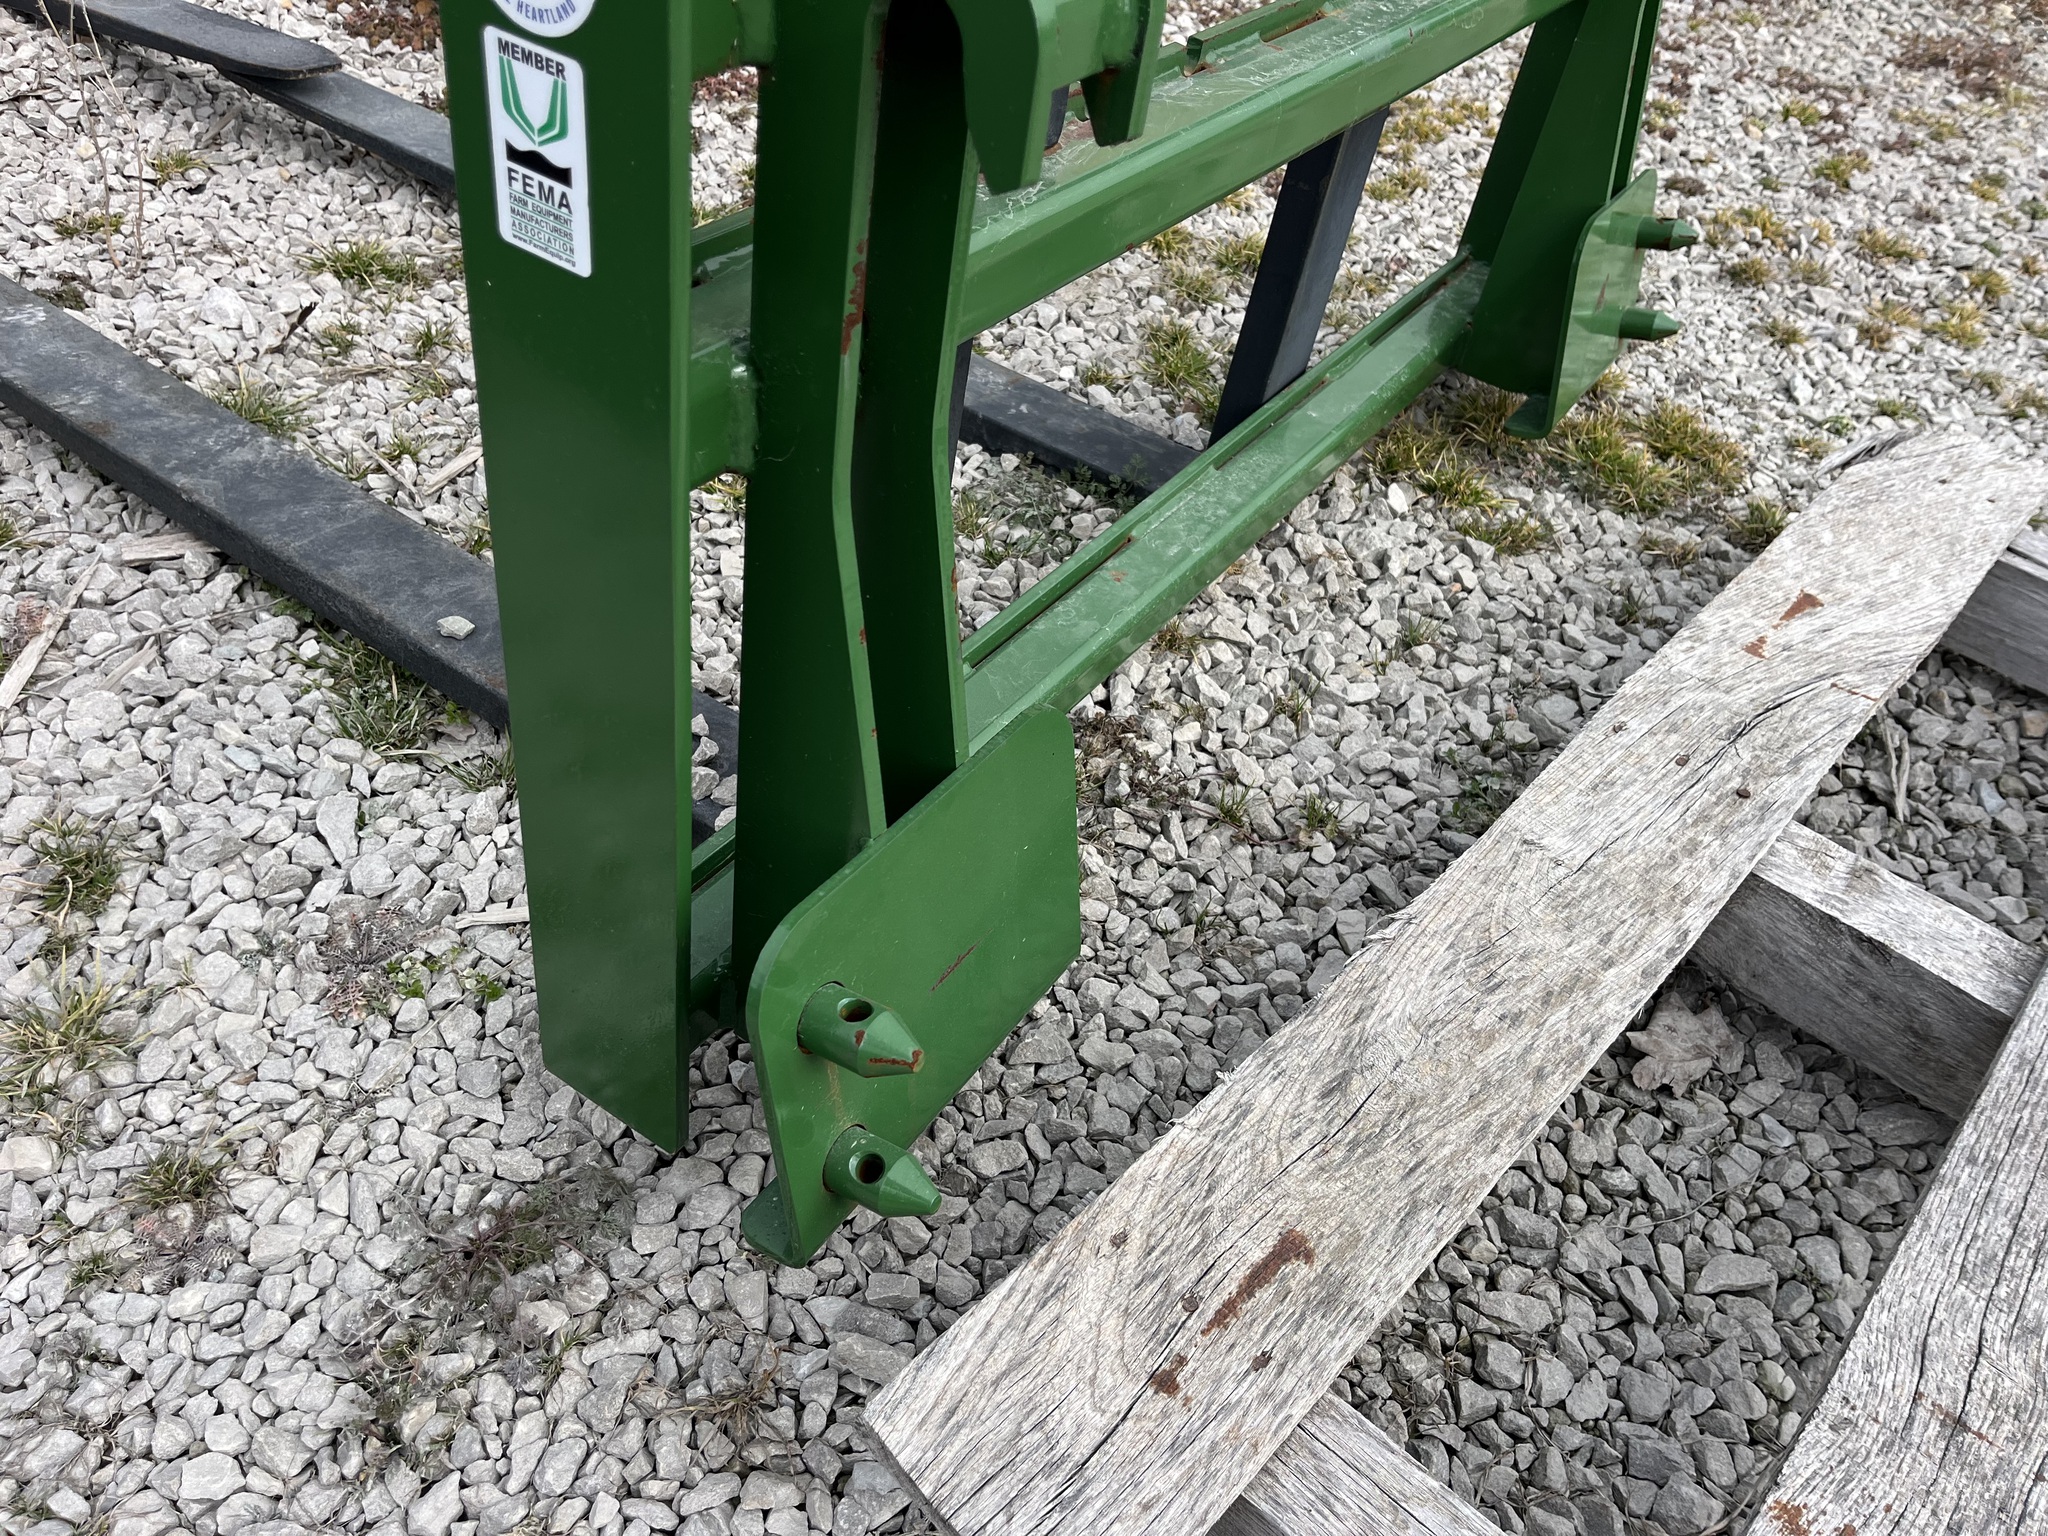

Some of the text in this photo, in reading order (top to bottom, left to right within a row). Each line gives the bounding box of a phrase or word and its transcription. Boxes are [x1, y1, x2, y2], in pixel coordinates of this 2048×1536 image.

[517, 0, 576, 24] HEARTLAND
[497, 36, 567, 81] MEMBER
[507, 166, 573, 215] FEMA
[509, 191, 573, 229] FARM EQUIPMENT
[510, 205, 574, 242] MANUFACTURERS
[511, 219, 575, 256] ASSOCIATION
[512, 232, 576, 268] www.FarmEquip.org
